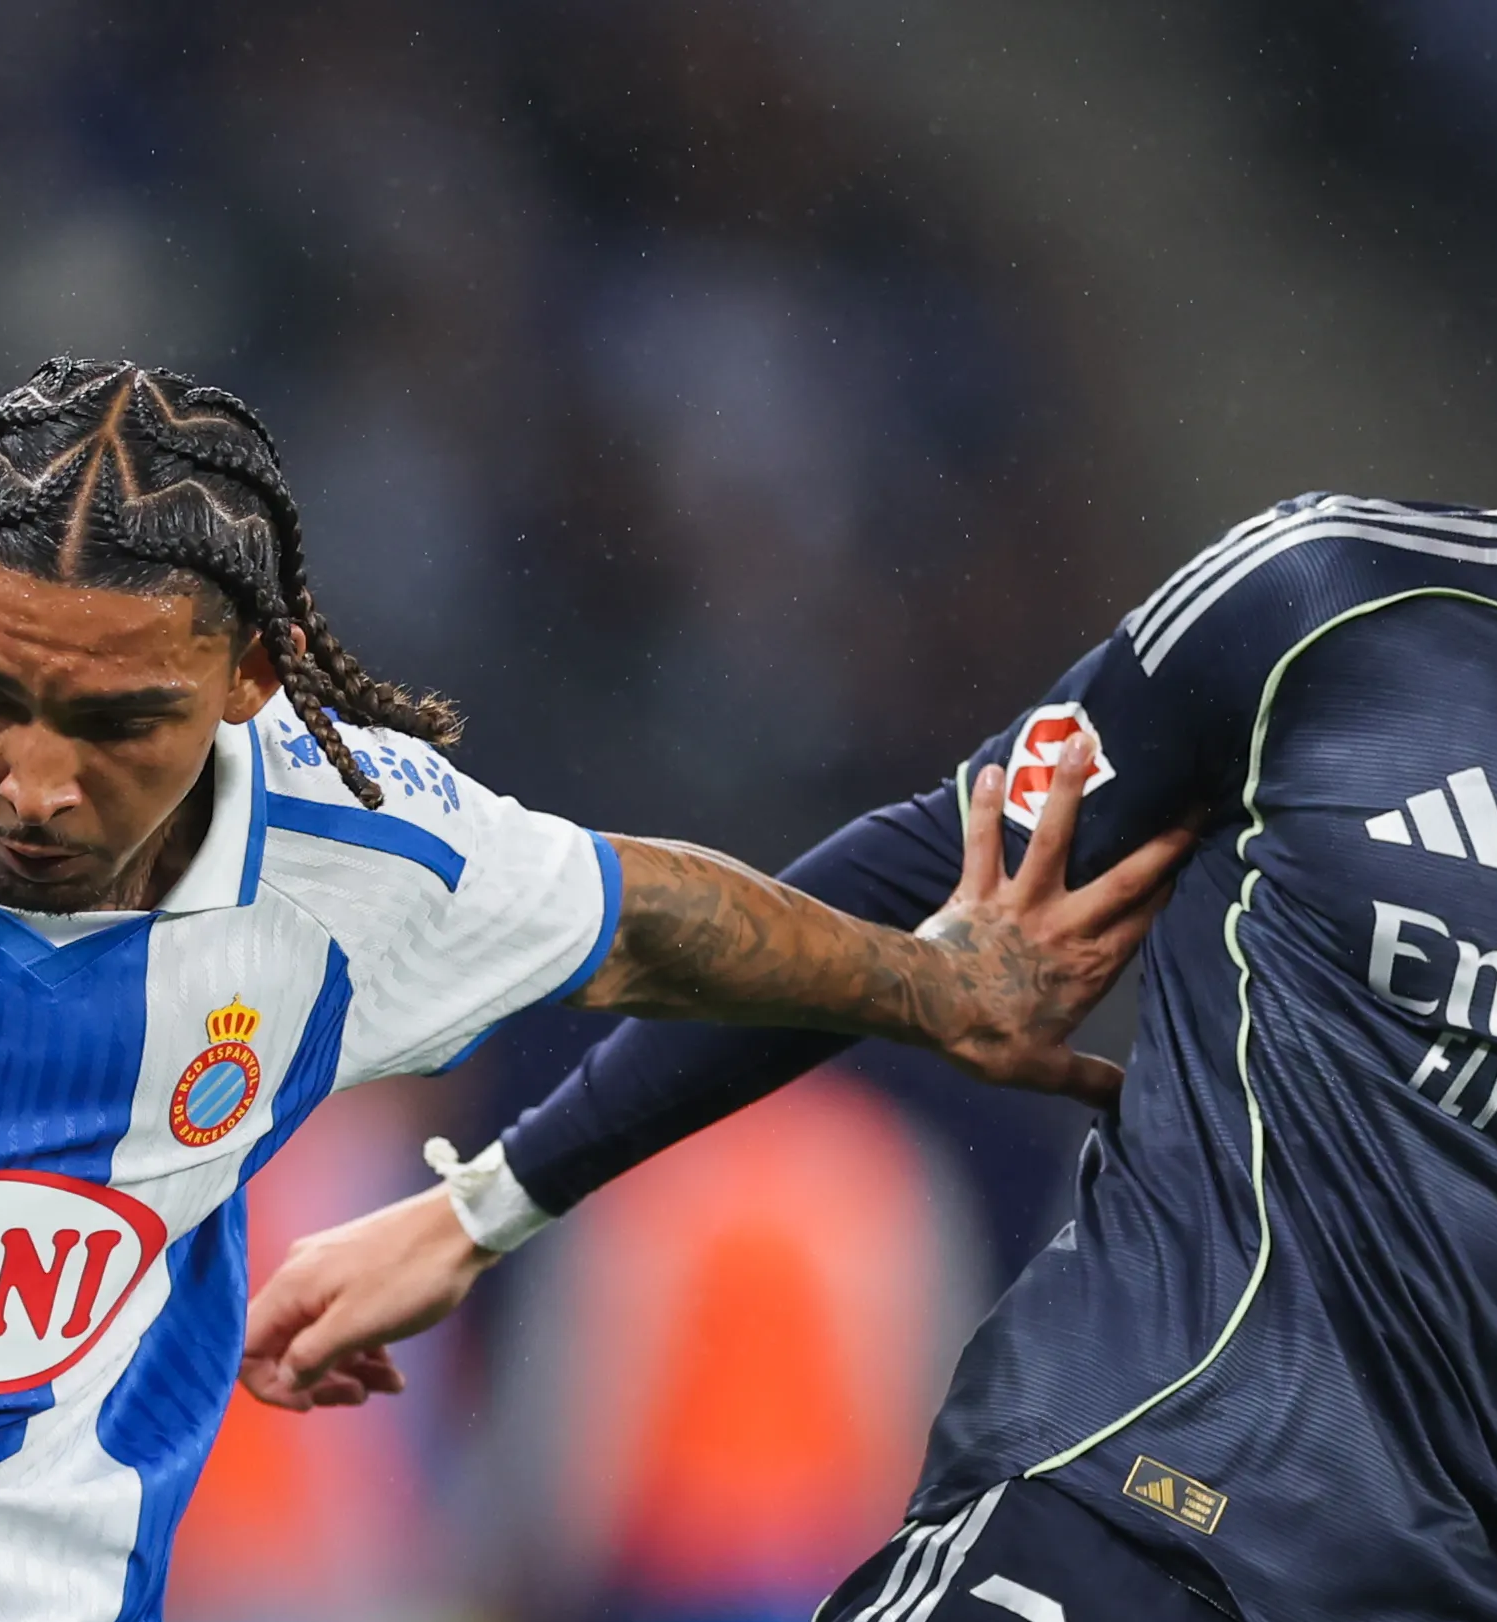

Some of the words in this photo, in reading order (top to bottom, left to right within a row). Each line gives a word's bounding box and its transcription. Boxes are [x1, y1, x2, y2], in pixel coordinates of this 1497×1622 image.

[178, 1061, 203, 1092] RCD
[207, 1045, 258, 1087] ESPANYOL
[174, 1104, 184, 1124] DE
[179, 1098, 253, 1143] BARCELONA
